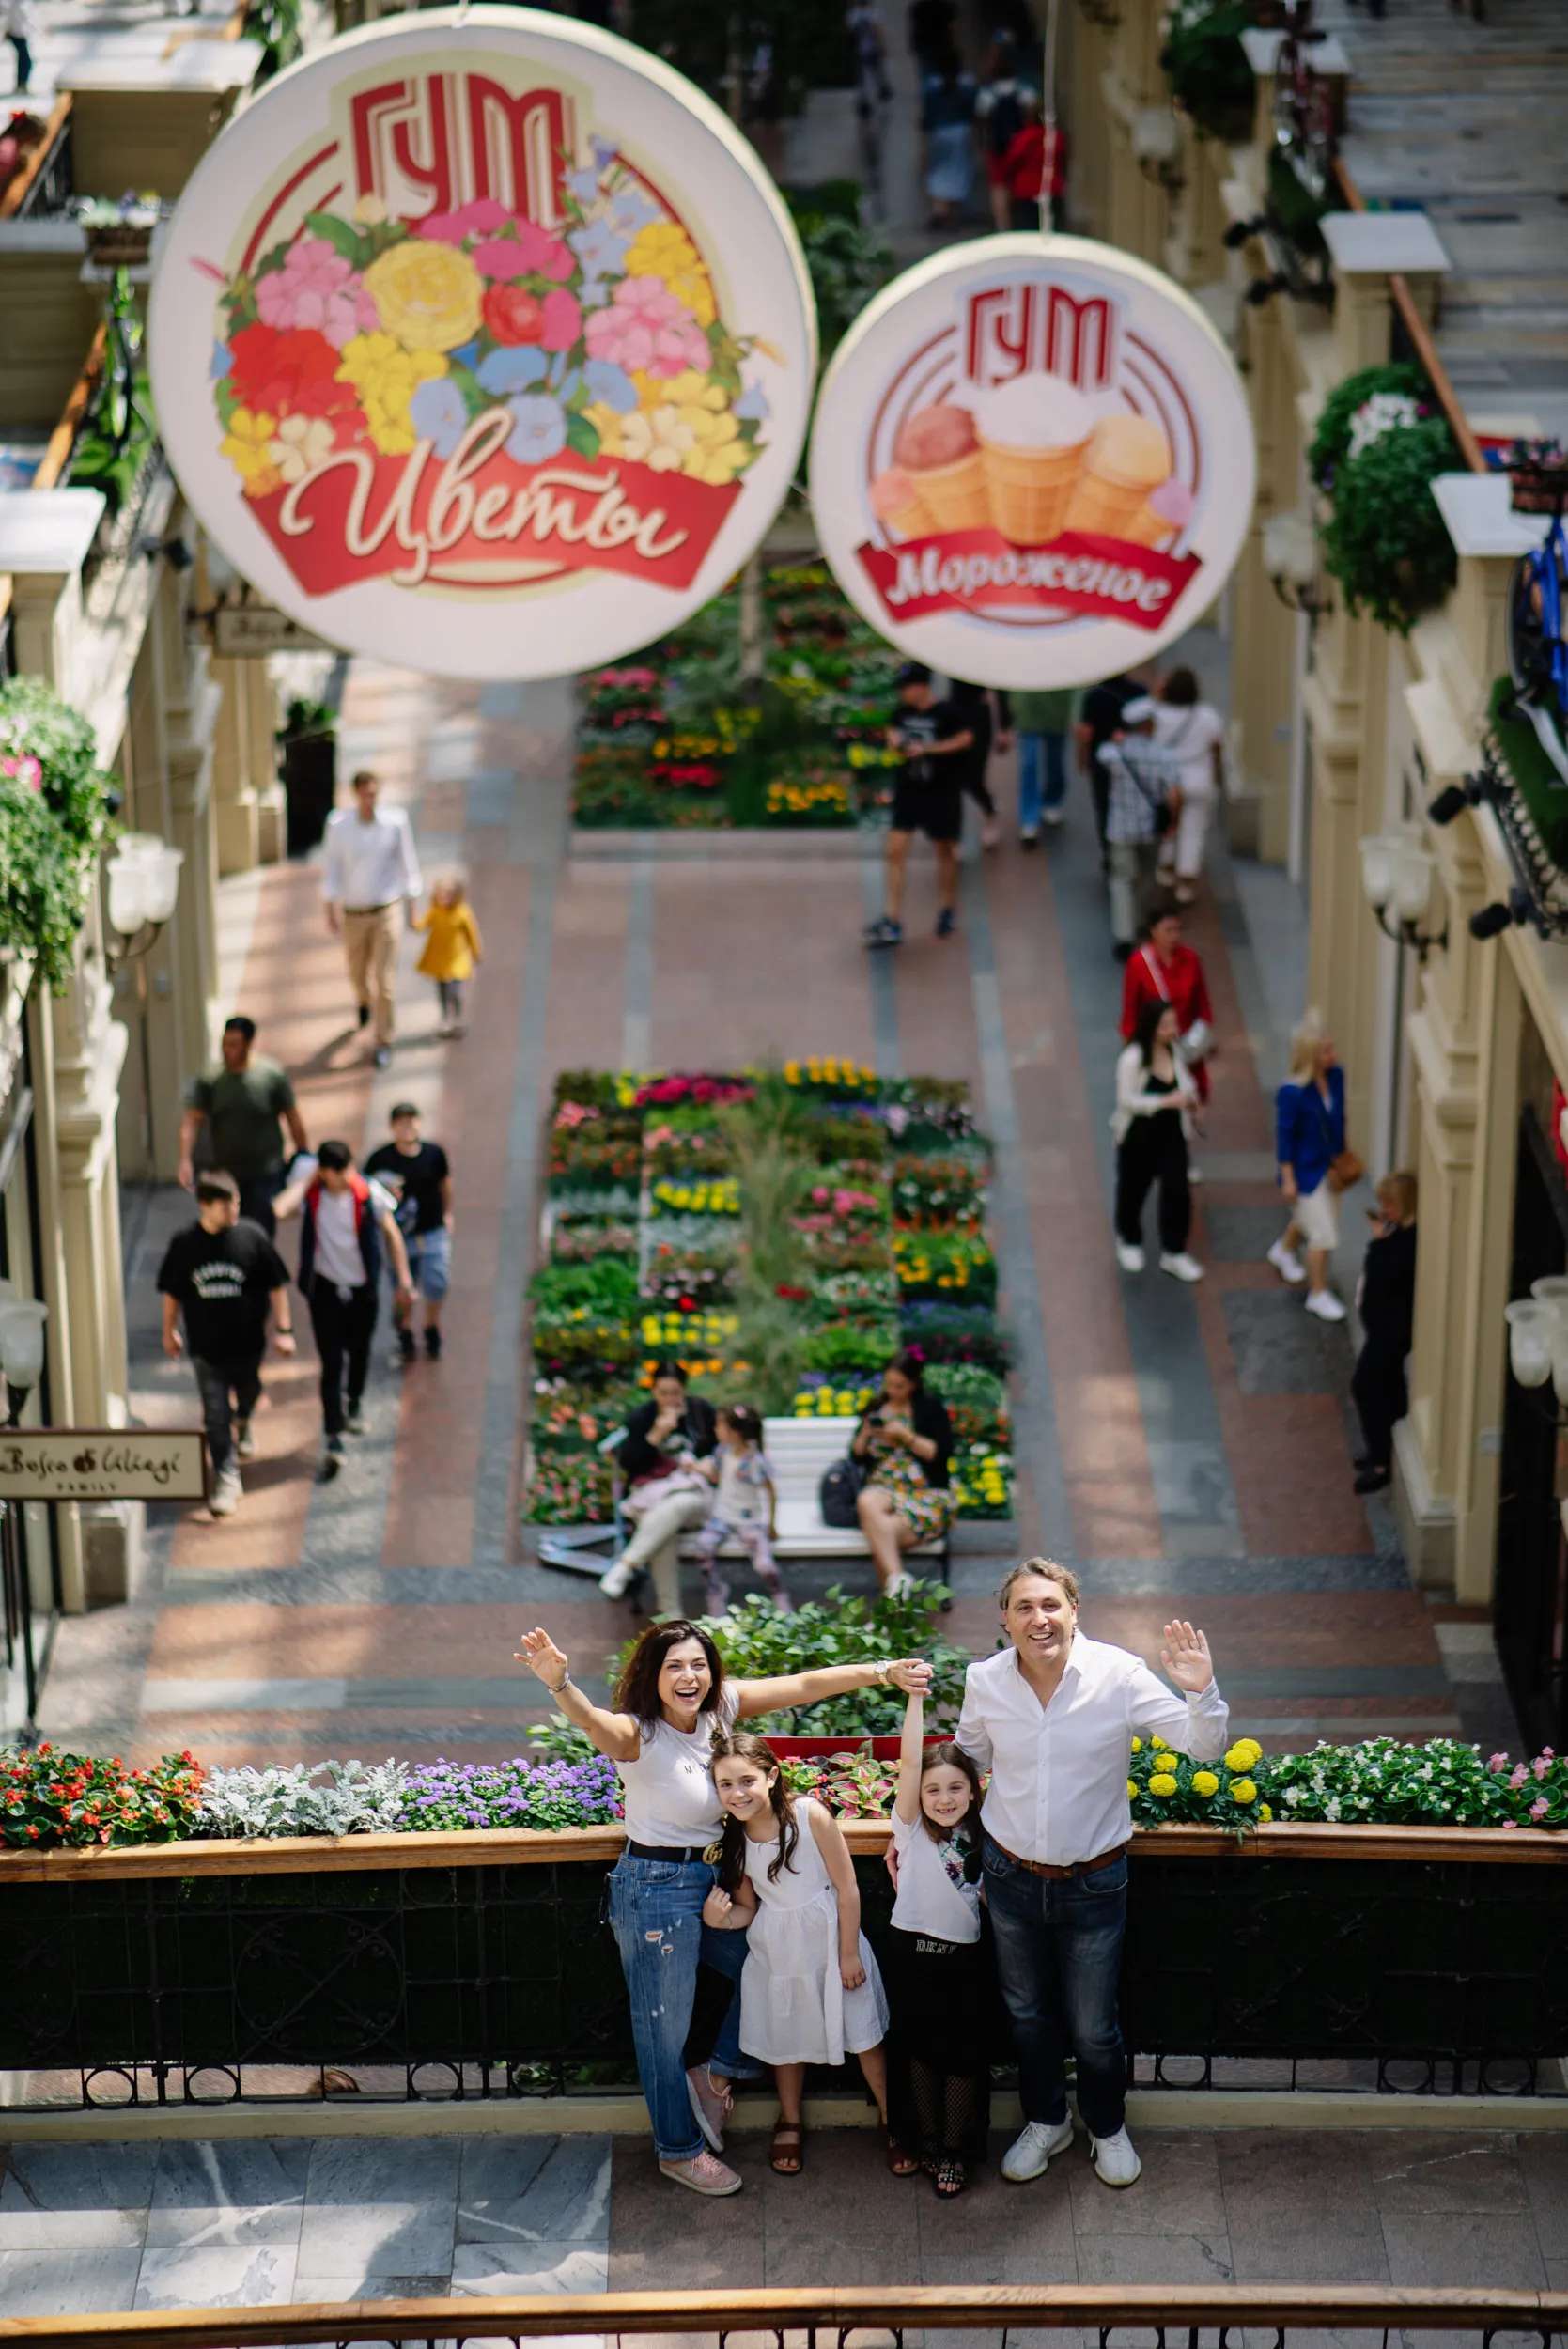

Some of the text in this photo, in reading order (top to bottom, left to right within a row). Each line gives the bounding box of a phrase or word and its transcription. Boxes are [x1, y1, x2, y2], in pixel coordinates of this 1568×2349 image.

[350, 73, 576, 227] ГУМ
[968, 285, 1114, 391] ГУМ
[279, 405, 688, 586] Цветы
[888, 548, 1172, 610] Мороженое
